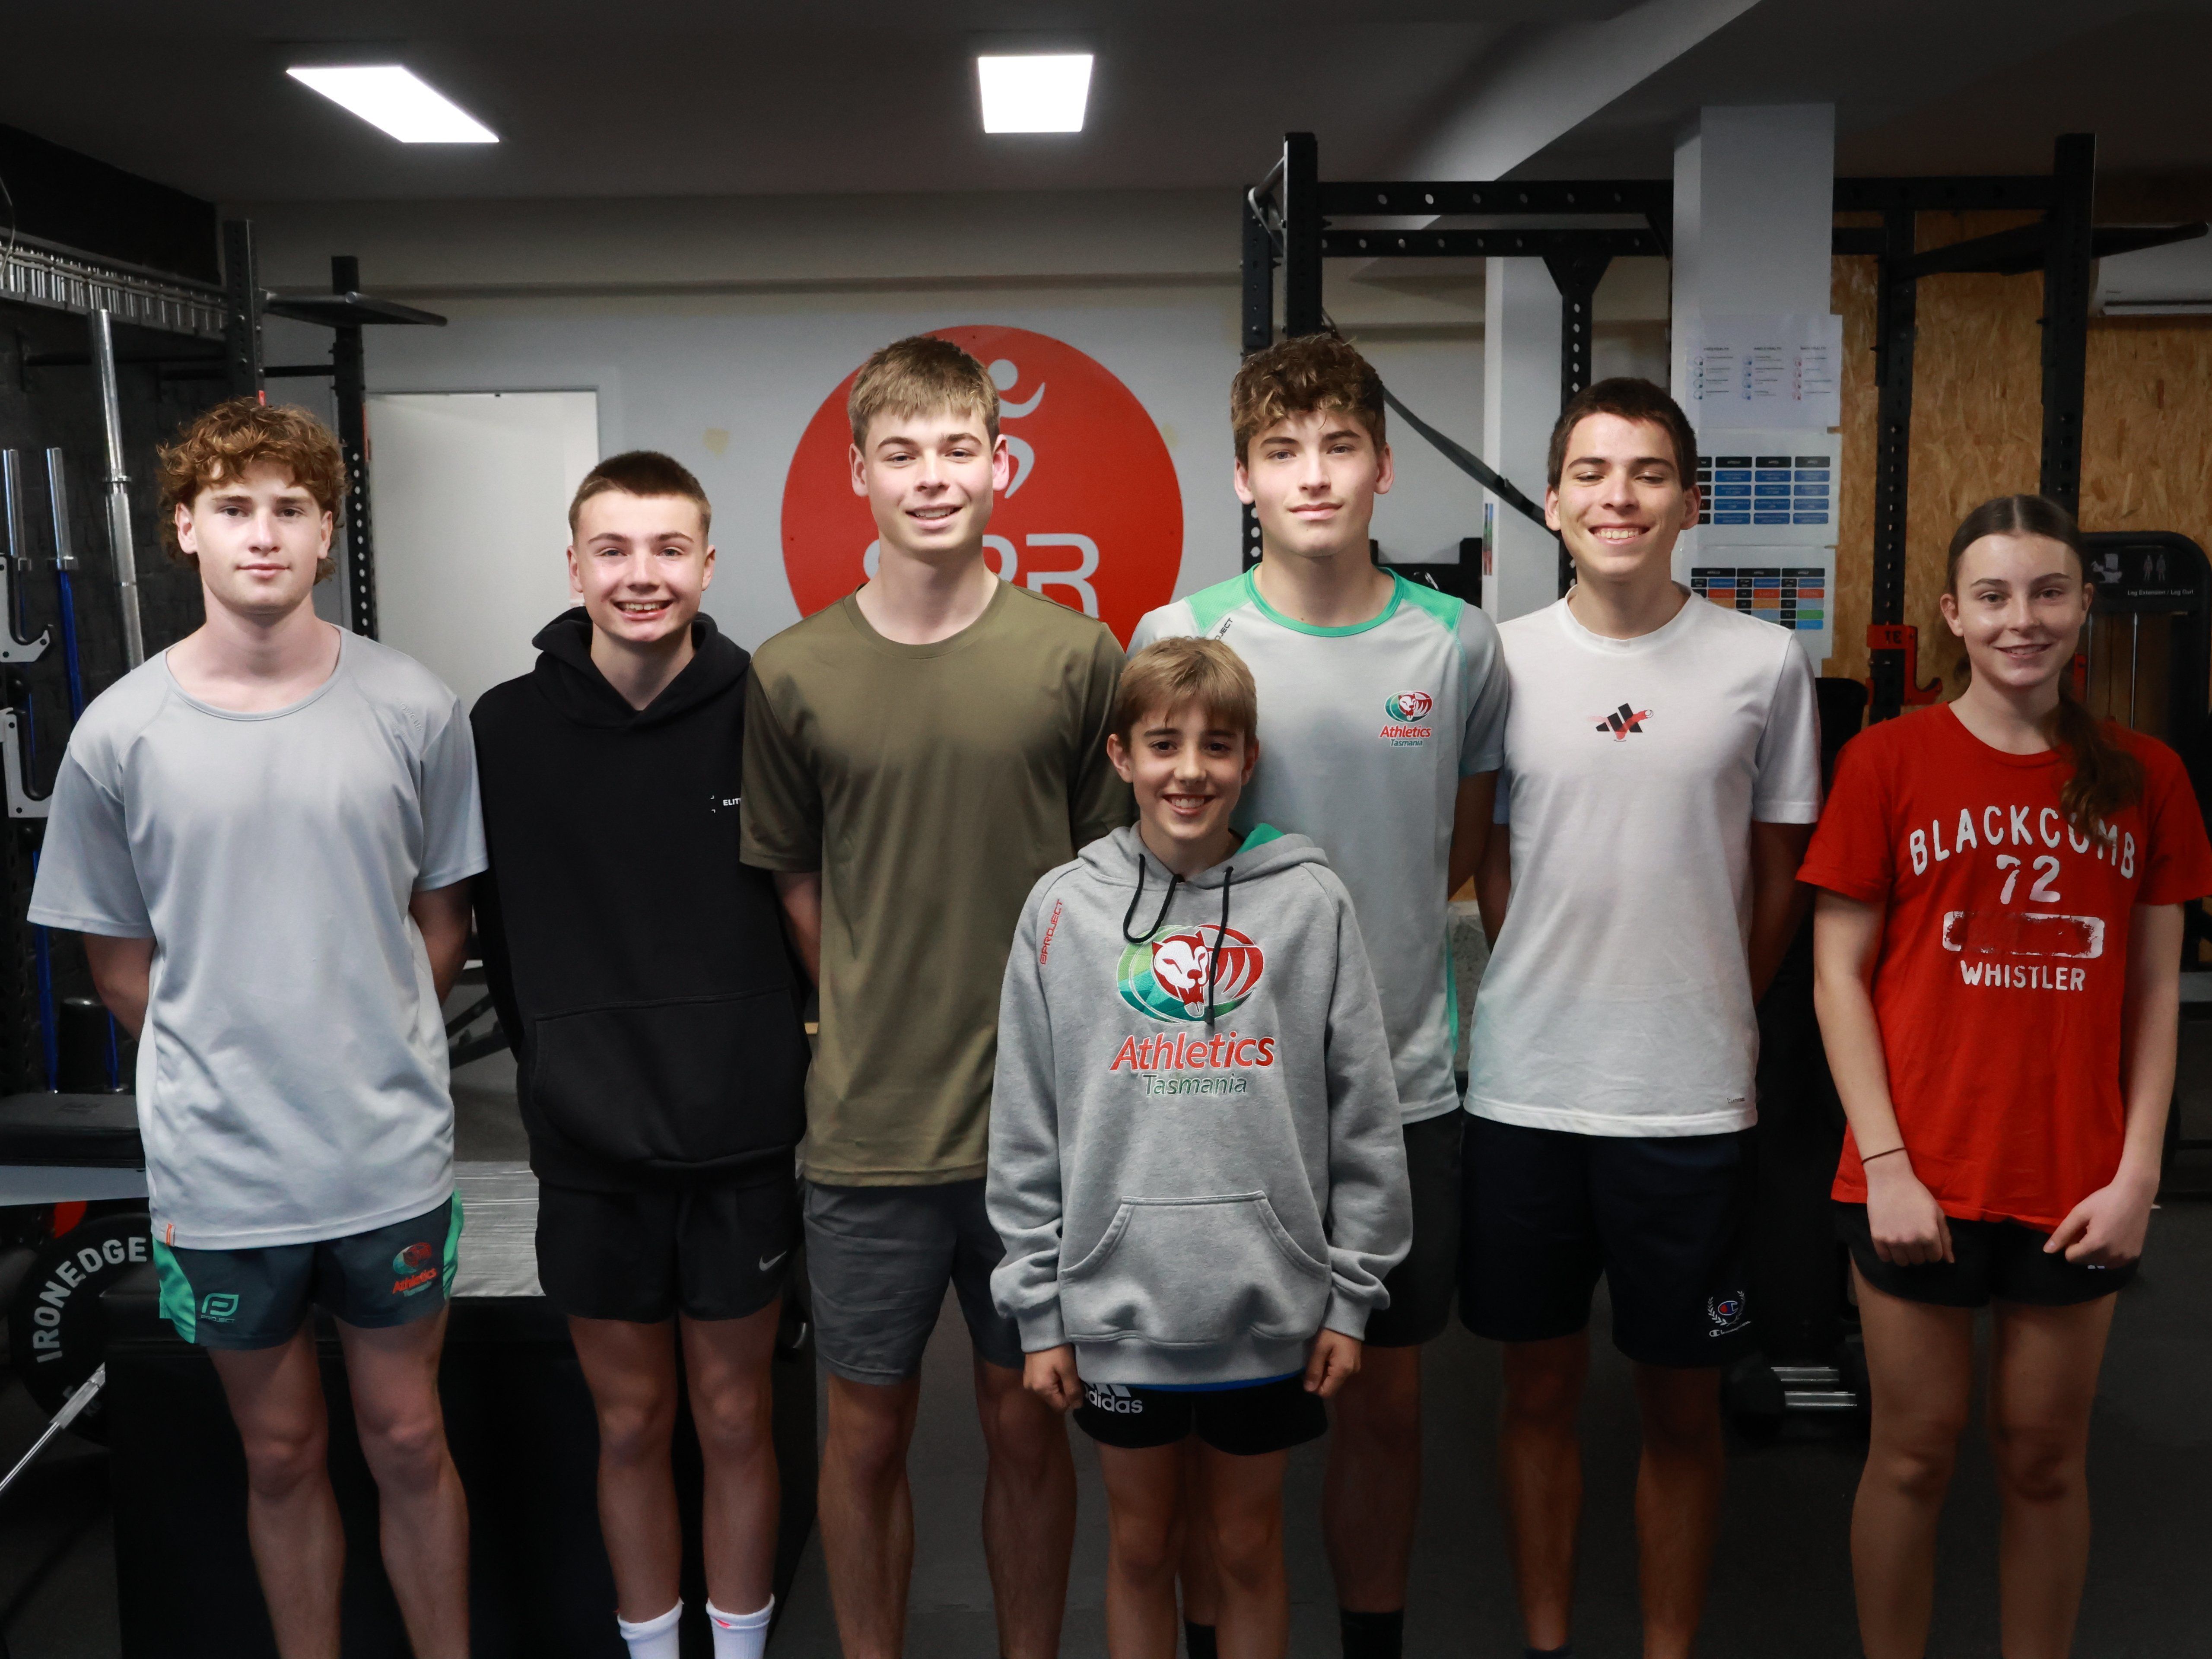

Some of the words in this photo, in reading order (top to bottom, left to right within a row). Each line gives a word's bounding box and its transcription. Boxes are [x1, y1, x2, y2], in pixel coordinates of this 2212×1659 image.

[1379, 725, 1431, 738] Athletics
[723, 798, 741, 806] ELIT
[1996, 855, 2061, 905] 72
[1960, 960, 2085, 991] WHISTLER
[1108, 1030, 1274, 1072] Athletics
[1142, 1073, 1247, 1095] Tasmania
